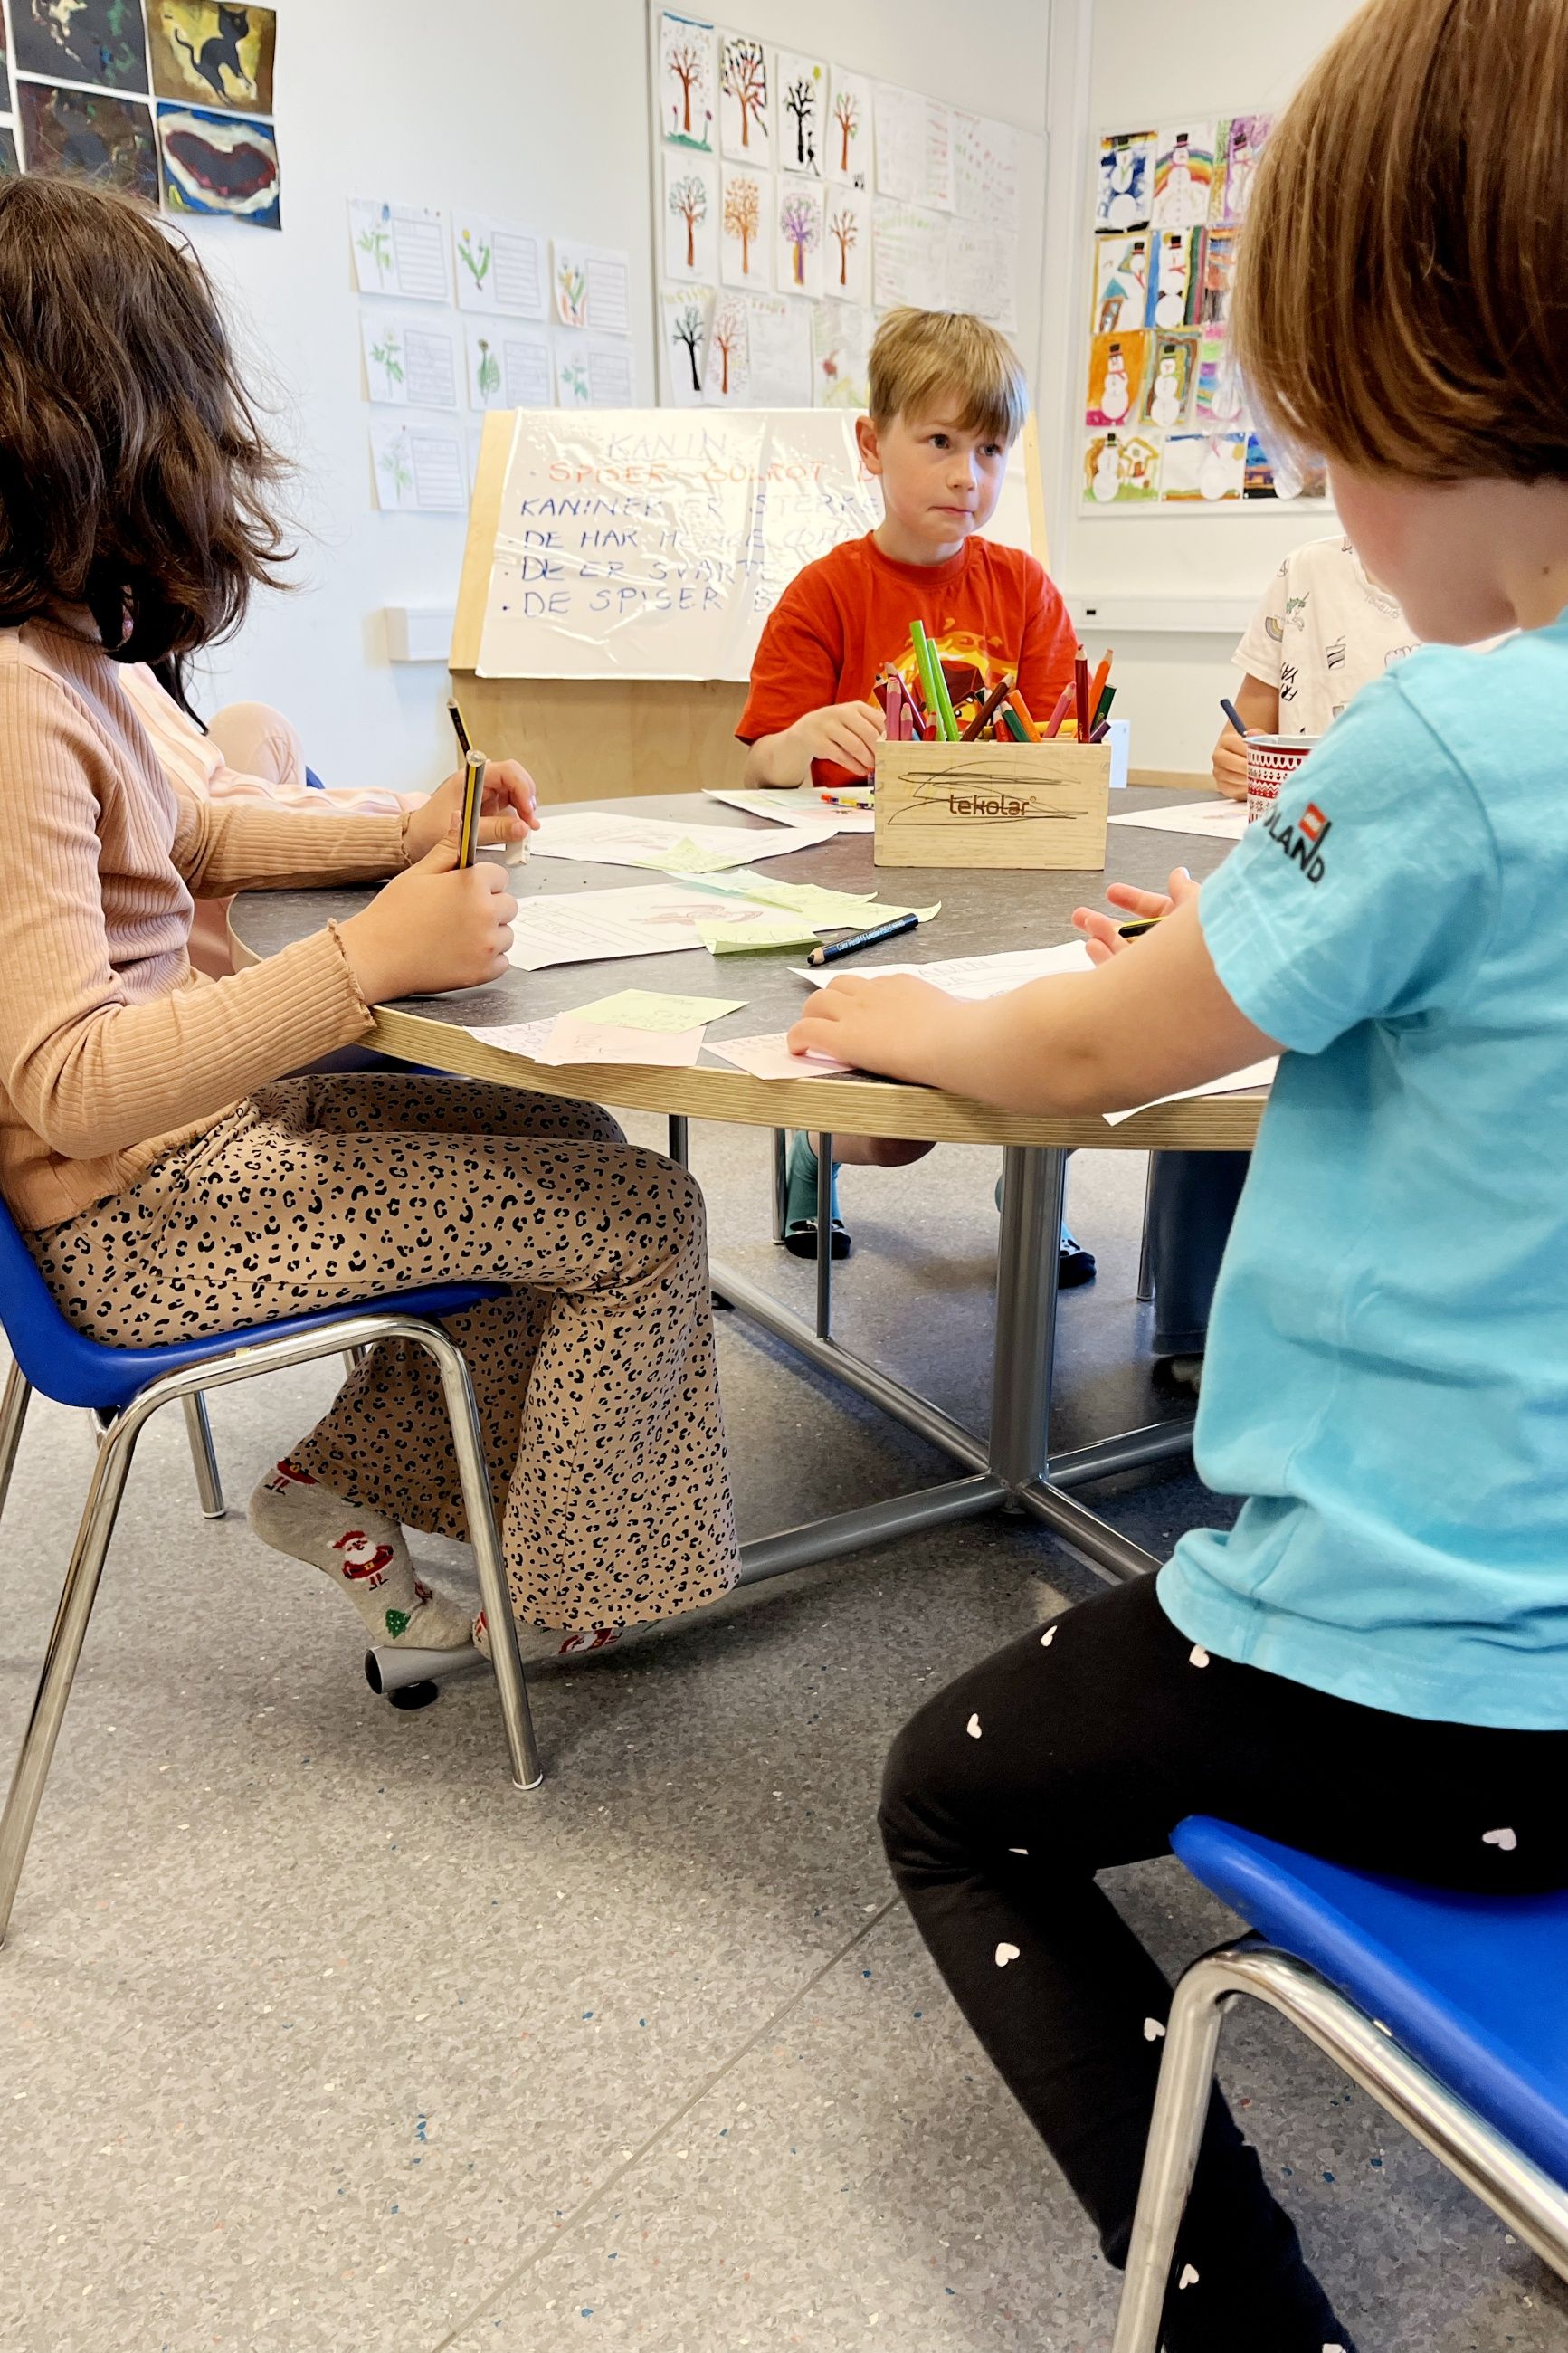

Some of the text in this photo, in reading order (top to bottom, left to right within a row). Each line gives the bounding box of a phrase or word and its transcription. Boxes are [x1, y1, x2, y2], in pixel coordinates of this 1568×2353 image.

[609, 433, 726, 459] KANIN
[524, 529, 565, 548] DE
[580, 529, 638, 548] HAR
[521, 555, 565, 581] DE
[523, 590, 572, 618] DE
[588, 586, 722, 614] SPISER
[949, 794, 1030, 816] tekolar
[1263, 805, 1332, 884] LAND
